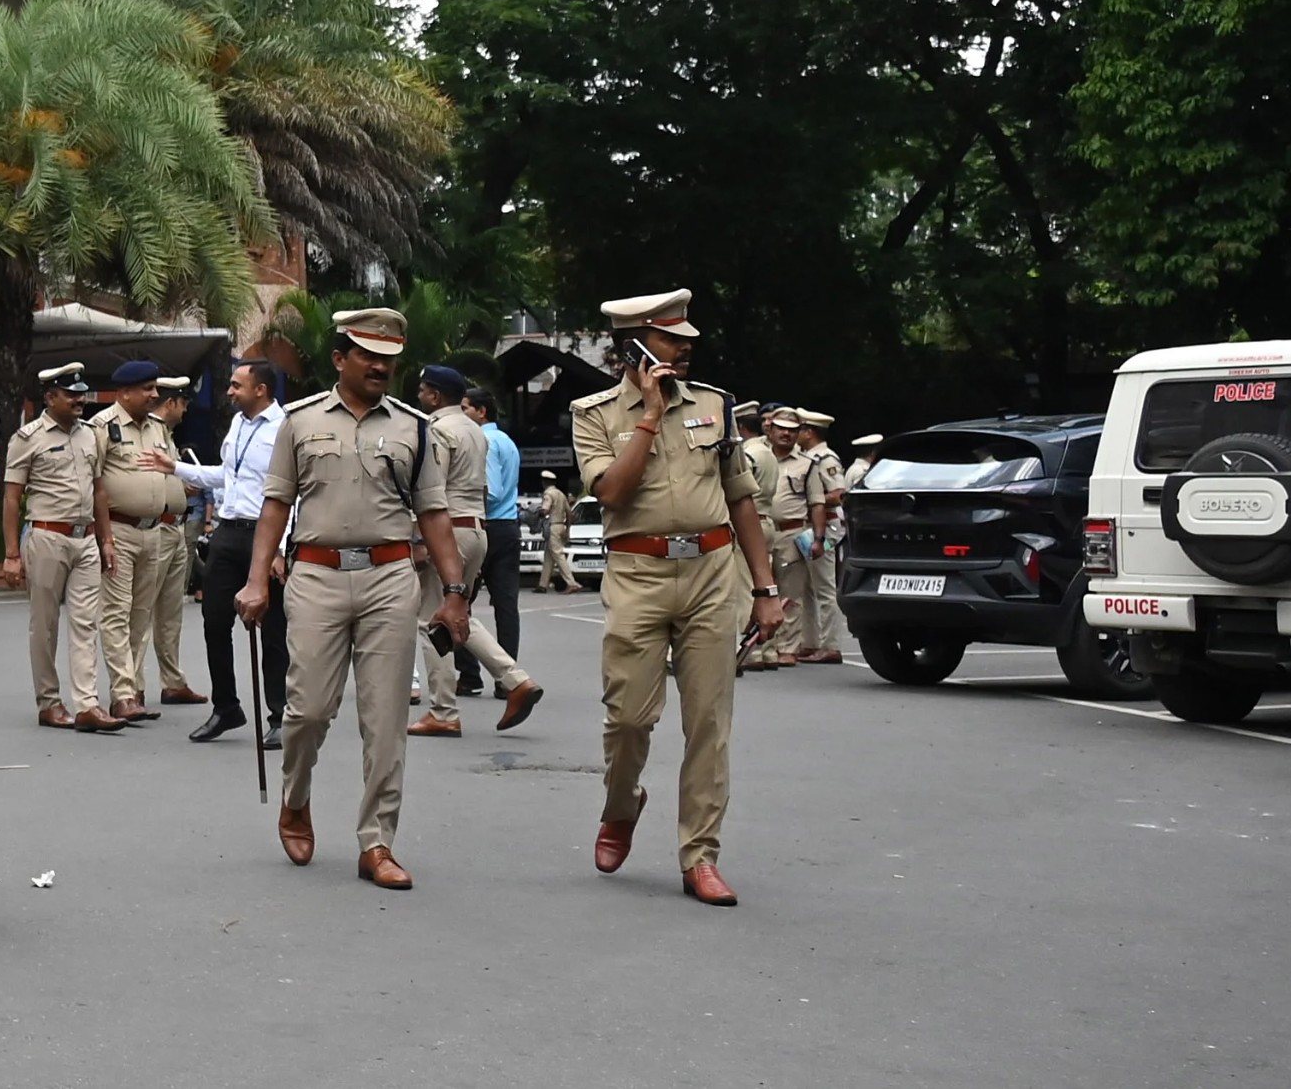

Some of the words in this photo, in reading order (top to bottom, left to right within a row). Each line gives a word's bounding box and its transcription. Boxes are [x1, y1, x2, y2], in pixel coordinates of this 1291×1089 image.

[1214, 381, 1276, 402] POLICE
[1200, 498, 1262, 512] BOLERO
[1105, 598, 1160, 616] POLICE
